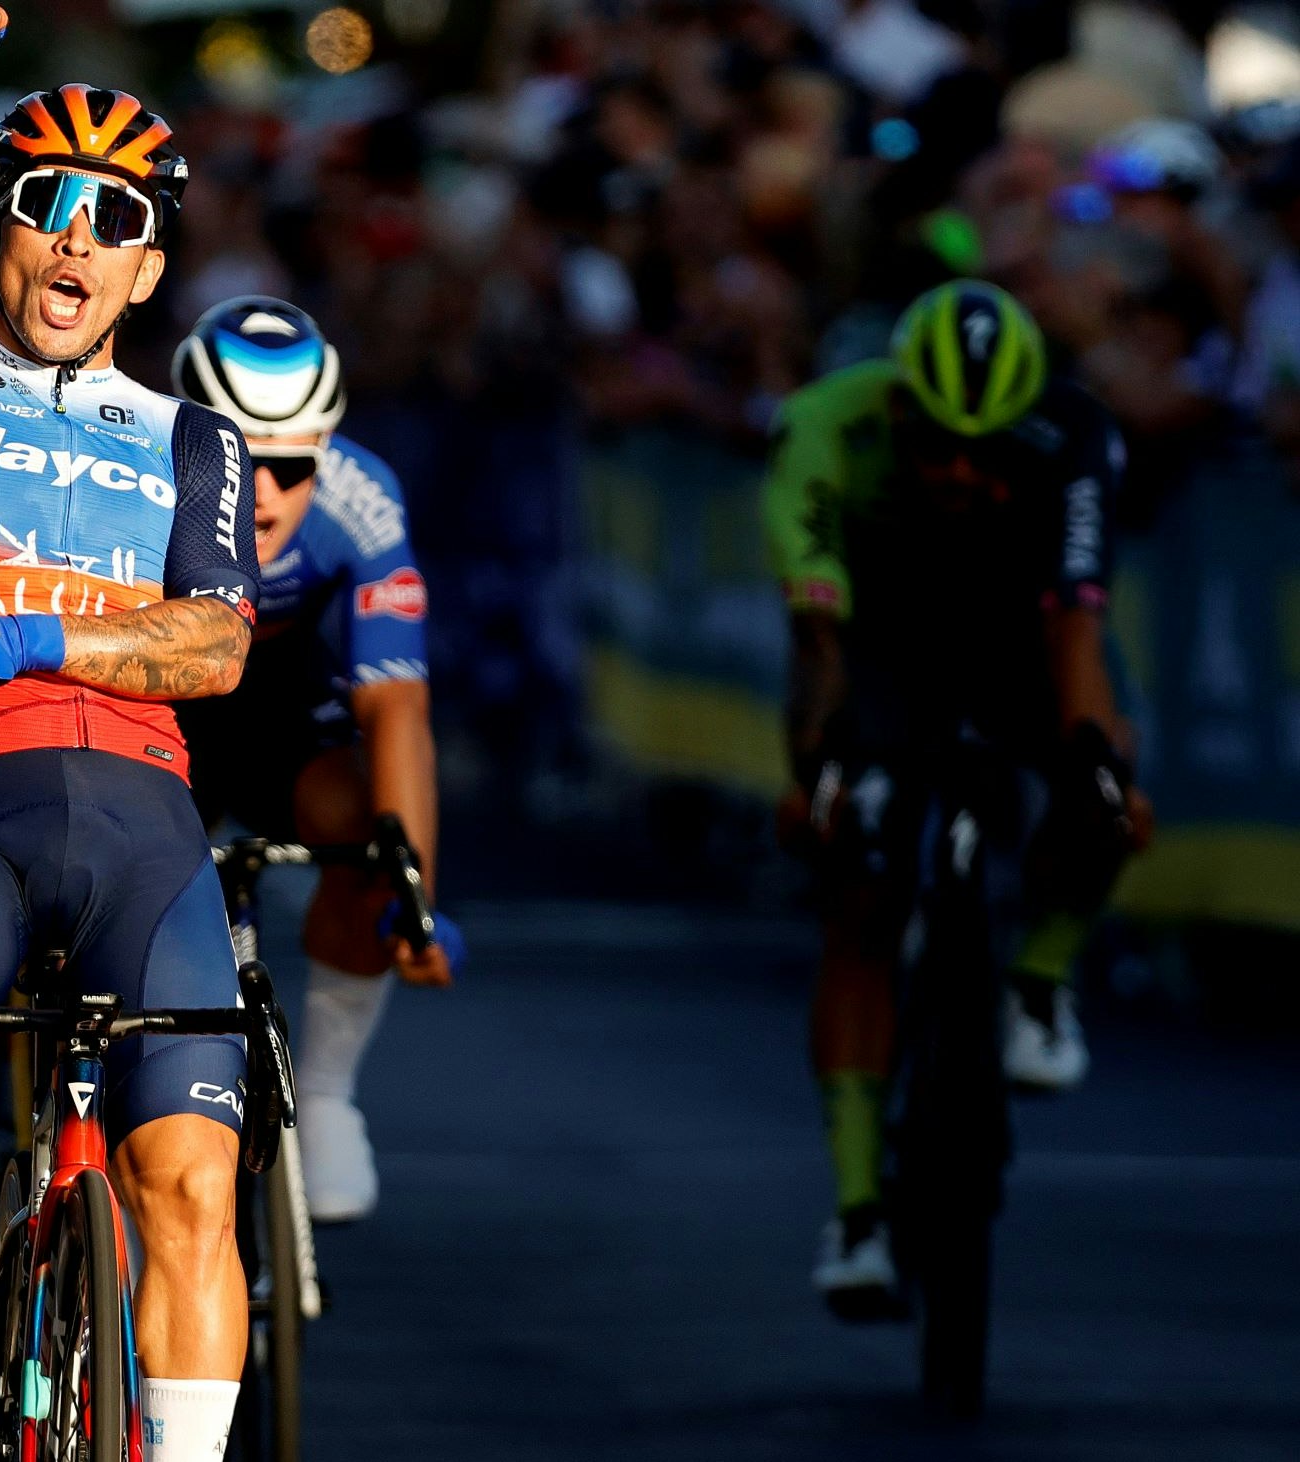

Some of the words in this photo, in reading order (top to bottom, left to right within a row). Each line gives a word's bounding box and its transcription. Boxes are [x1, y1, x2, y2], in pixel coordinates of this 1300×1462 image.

[84, 423, 152, 449] GreenEDGE
[216, 428, 241, 561] GIANT
[189, 1081, 245, 1128] CAD
